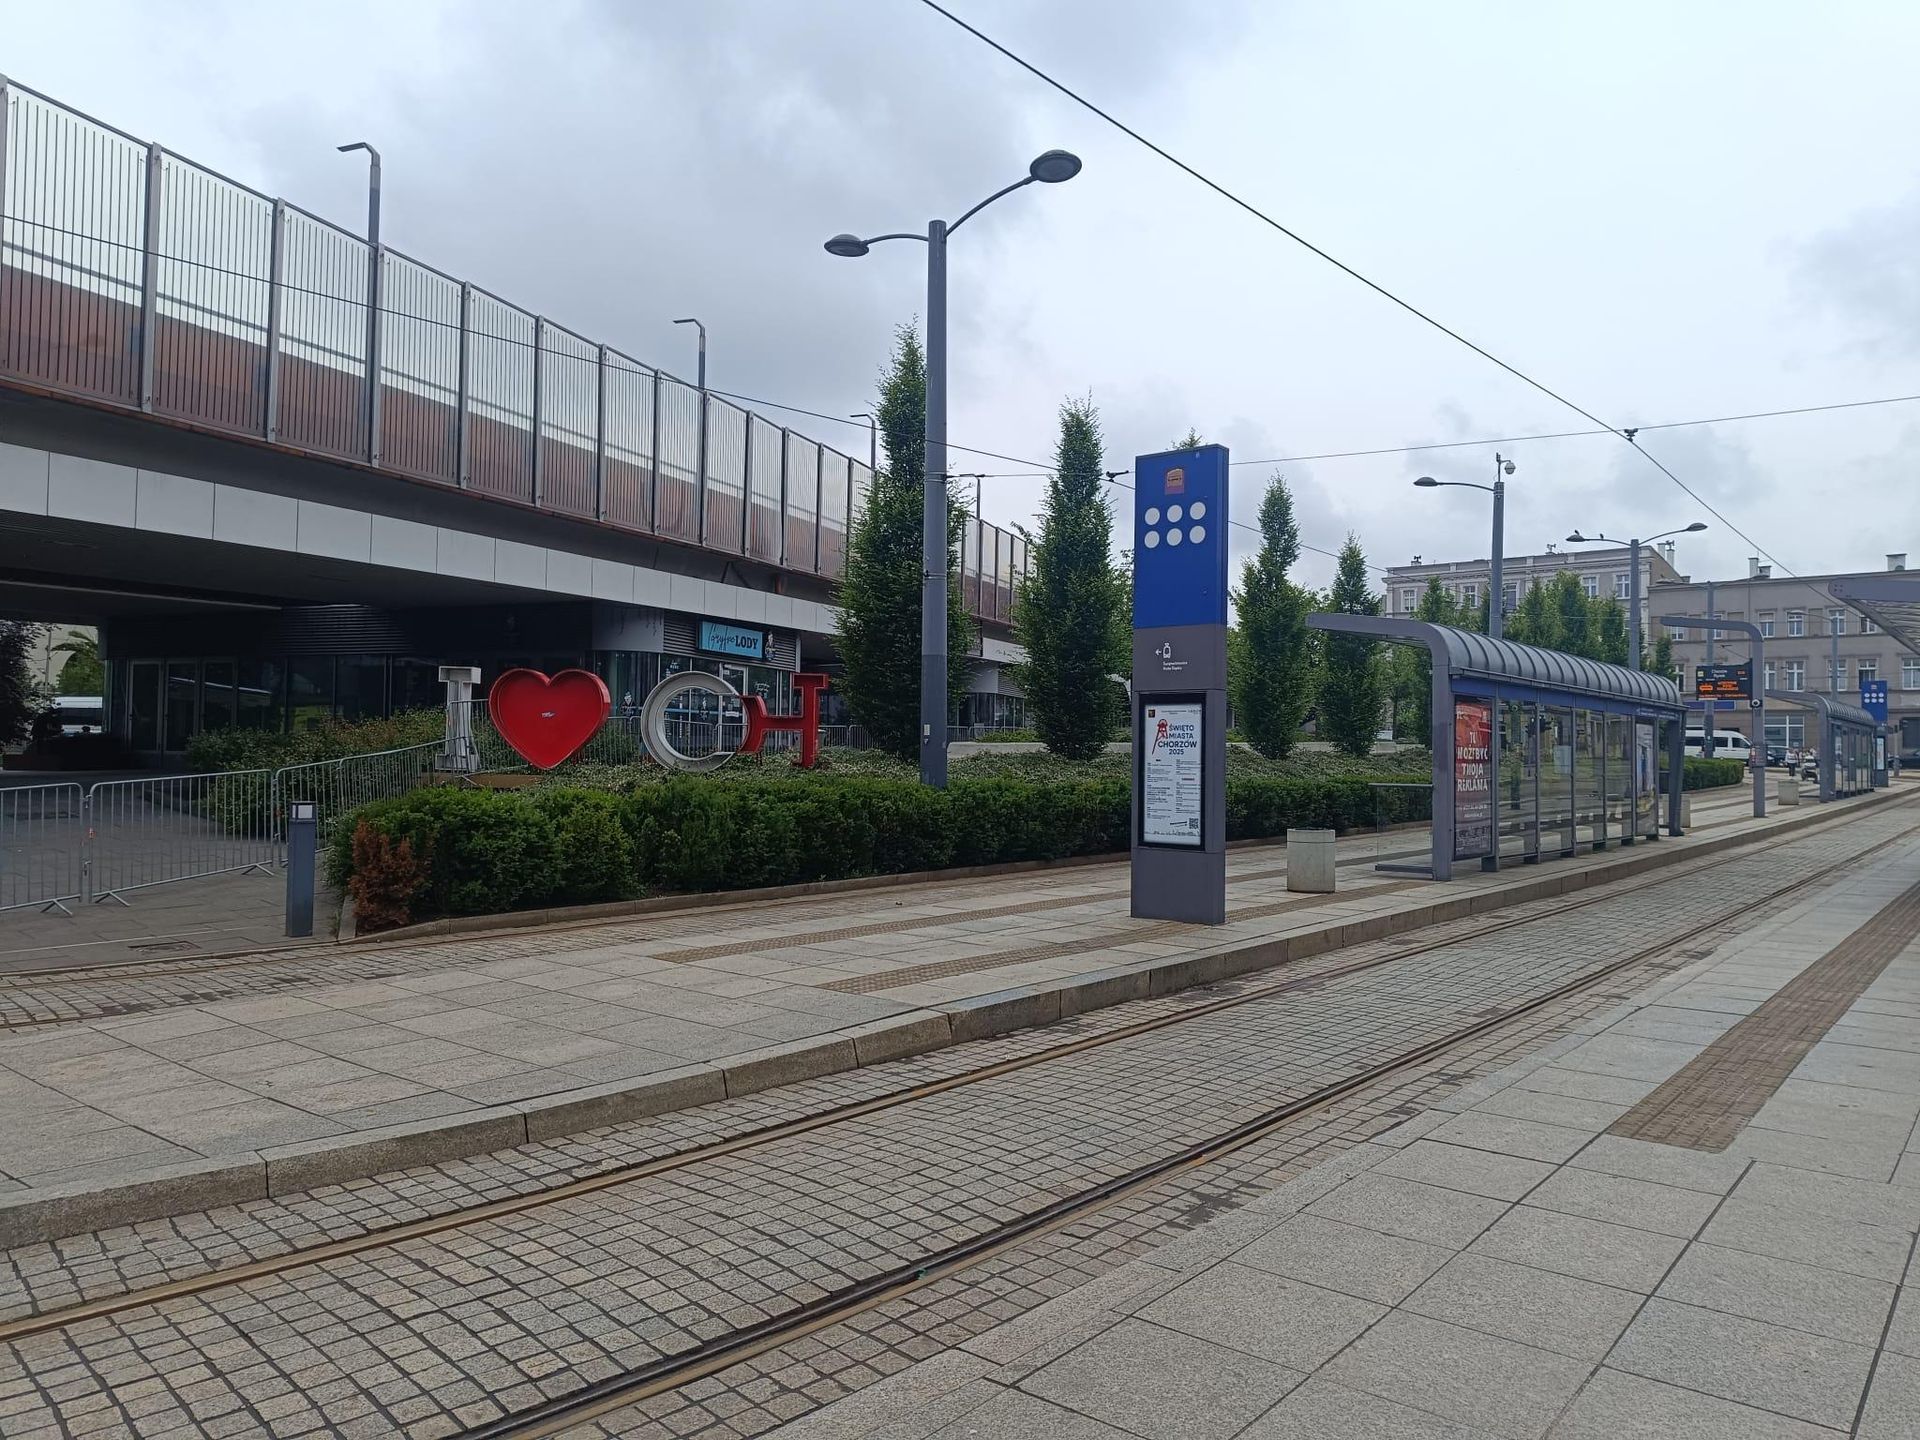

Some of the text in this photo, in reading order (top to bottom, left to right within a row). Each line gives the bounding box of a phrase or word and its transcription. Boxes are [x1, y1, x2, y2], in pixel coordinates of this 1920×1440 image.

[735, 635, 758, 649] LODY
[1169, 724, 1194, 732] ŚWIĘTO
[1157, 739, 1197, 748] CHORZÓW
[1476, 746, 1488, 760] BYĆ
[1461, 763, 1484, 777] TWOJA
[1457, 779, 1488, 792] REKLAMA
